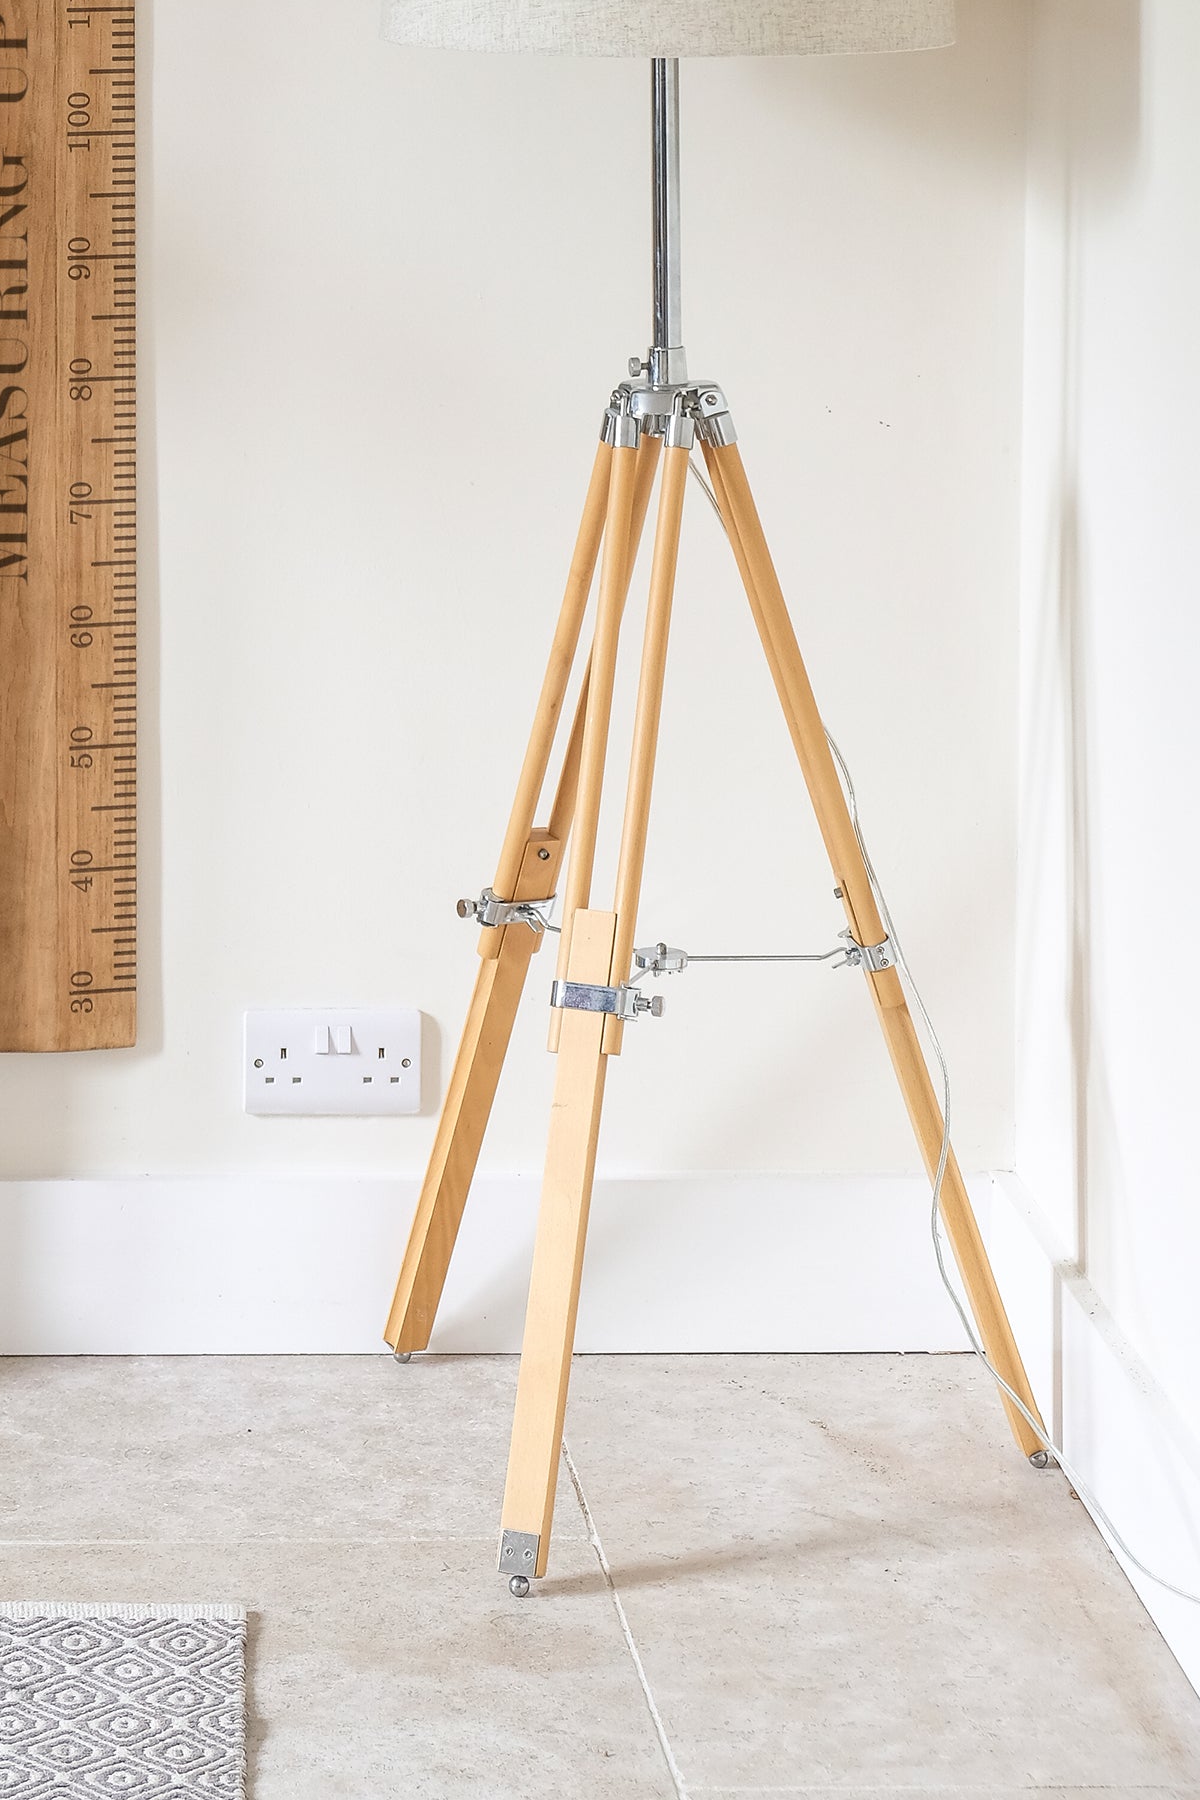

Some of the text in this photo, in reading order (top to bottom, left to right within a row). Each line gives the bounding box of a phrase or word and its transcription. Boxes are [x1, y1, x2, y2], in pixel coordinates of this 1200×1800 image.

[68, 92, 90, 152] 100
[68, 237, 90, 280] 90
[69, 358, 92, 401] 80
[69, 482, 92, 524] 70
[71, 605, 93, 648] 60
[71, 726, 93, 769] 50
[71, 850, 93, 892] 40
[71, 971, 93, 1014] 30
